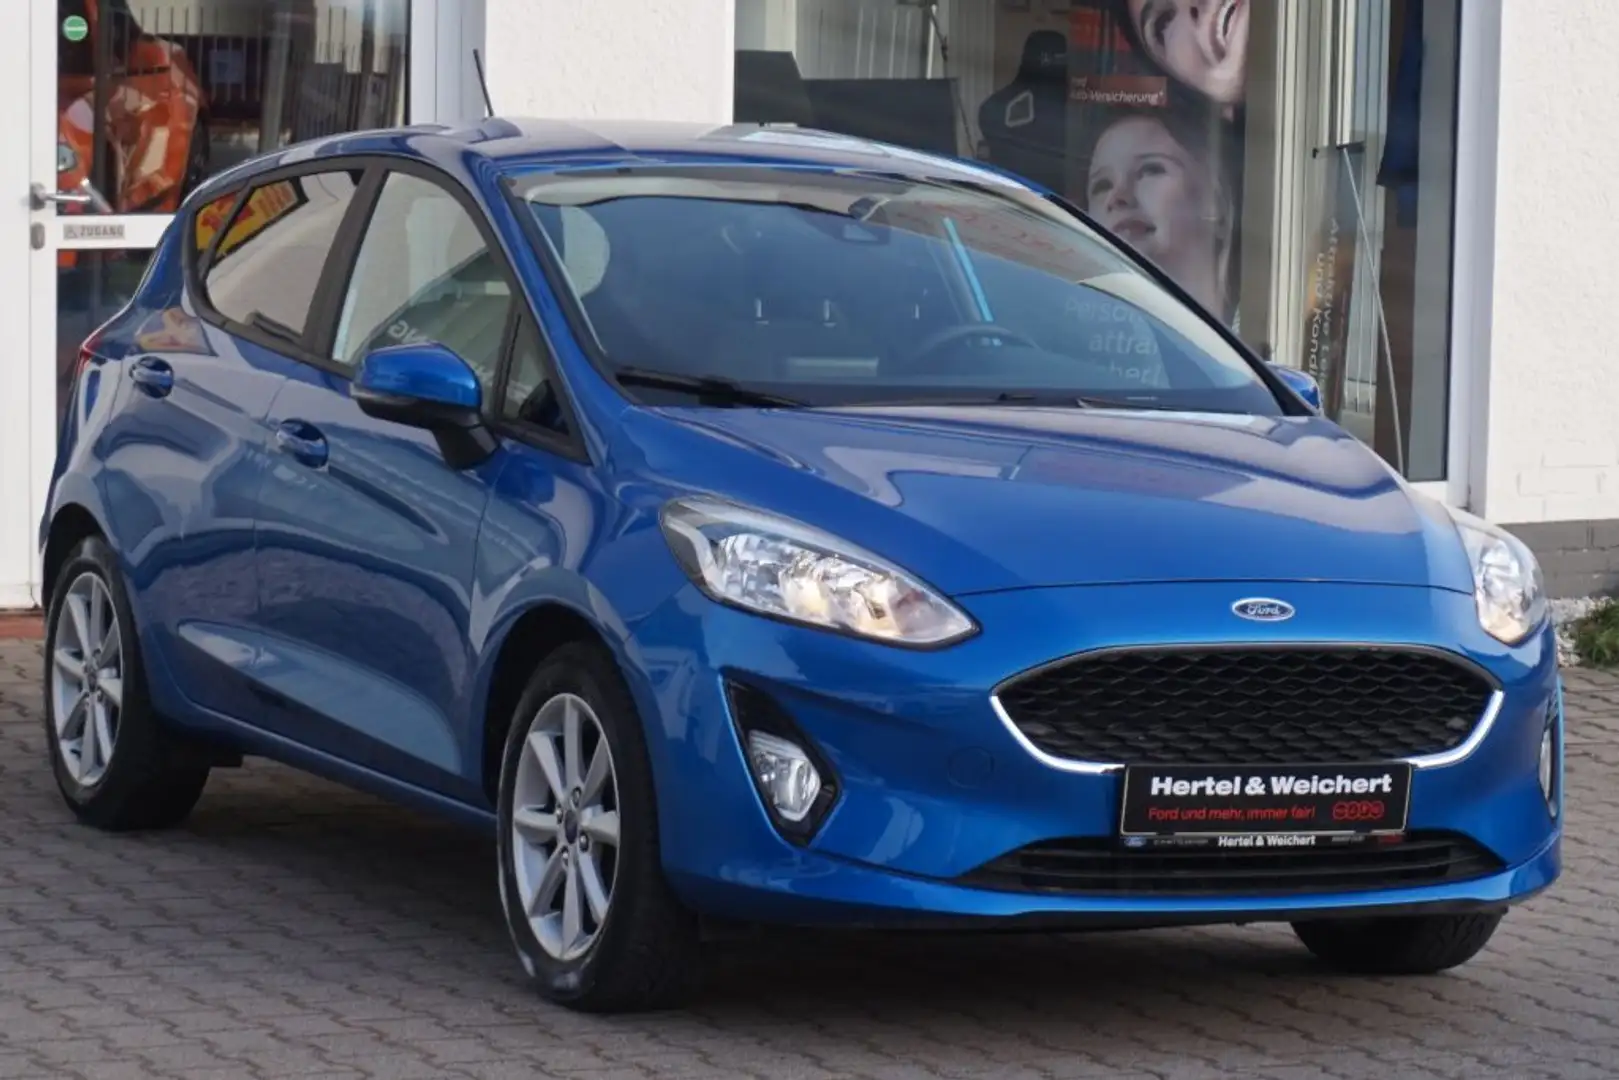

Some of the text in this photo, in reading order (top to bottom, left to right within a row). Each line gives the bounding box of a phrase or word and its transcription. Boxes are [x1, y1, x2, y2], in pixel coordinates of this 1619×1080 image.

[1247, 603, 1279, 616] Ford
[1150, 773, 1393, 797] Hertel & Weichert
[1148, 807, 1179, 820] Ford
[1181, 807, 1206, 820] und
[1208, 806, 1245, 821] mehr,
[1246, 806, 1288, 820] immer
[1217, 835, 1253, 847] Hertel
[1255, 835, 1265, 847] &
[1266, 834, 1316, 847] Weichert
